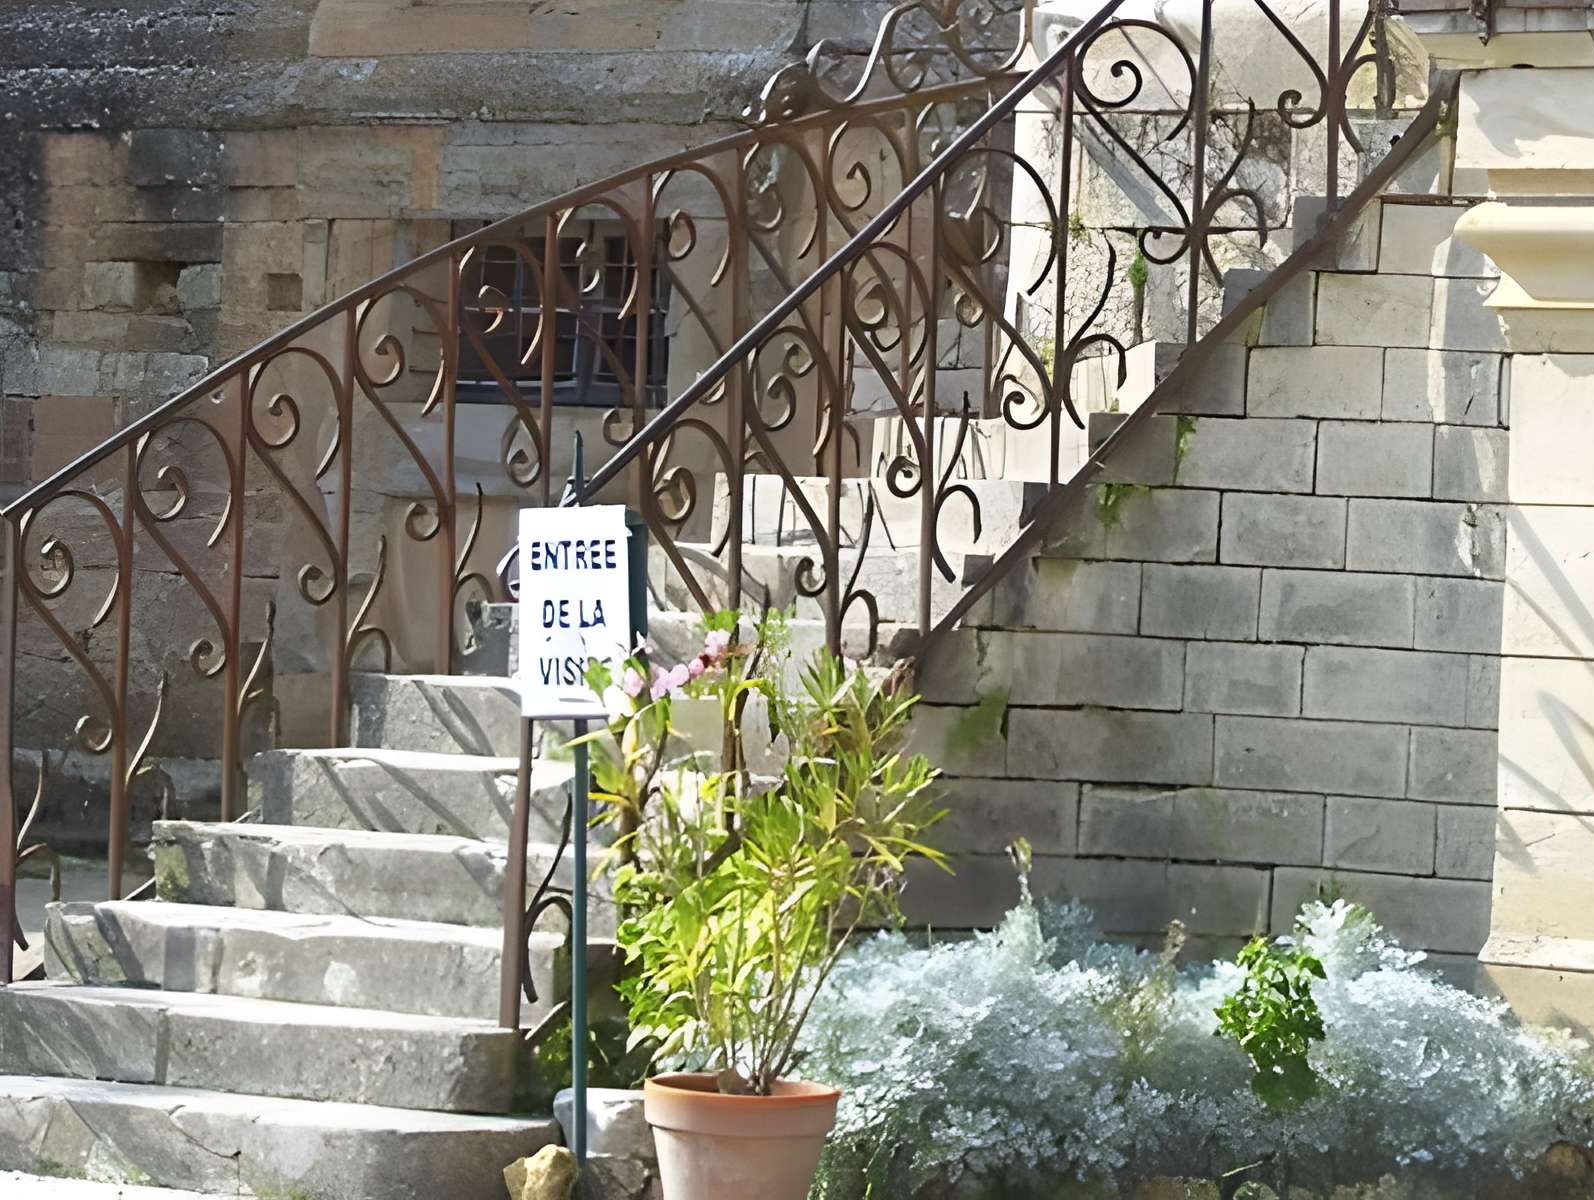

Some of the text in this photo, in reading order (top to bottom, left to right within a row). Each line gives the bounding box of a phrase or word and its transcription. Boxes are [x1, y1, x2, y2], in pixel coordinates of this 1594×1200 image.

[531, 539, 617, 570] ENTREE
[542, 599, 606, 628] DE LA
[540, 656, 612, 686] VISI
